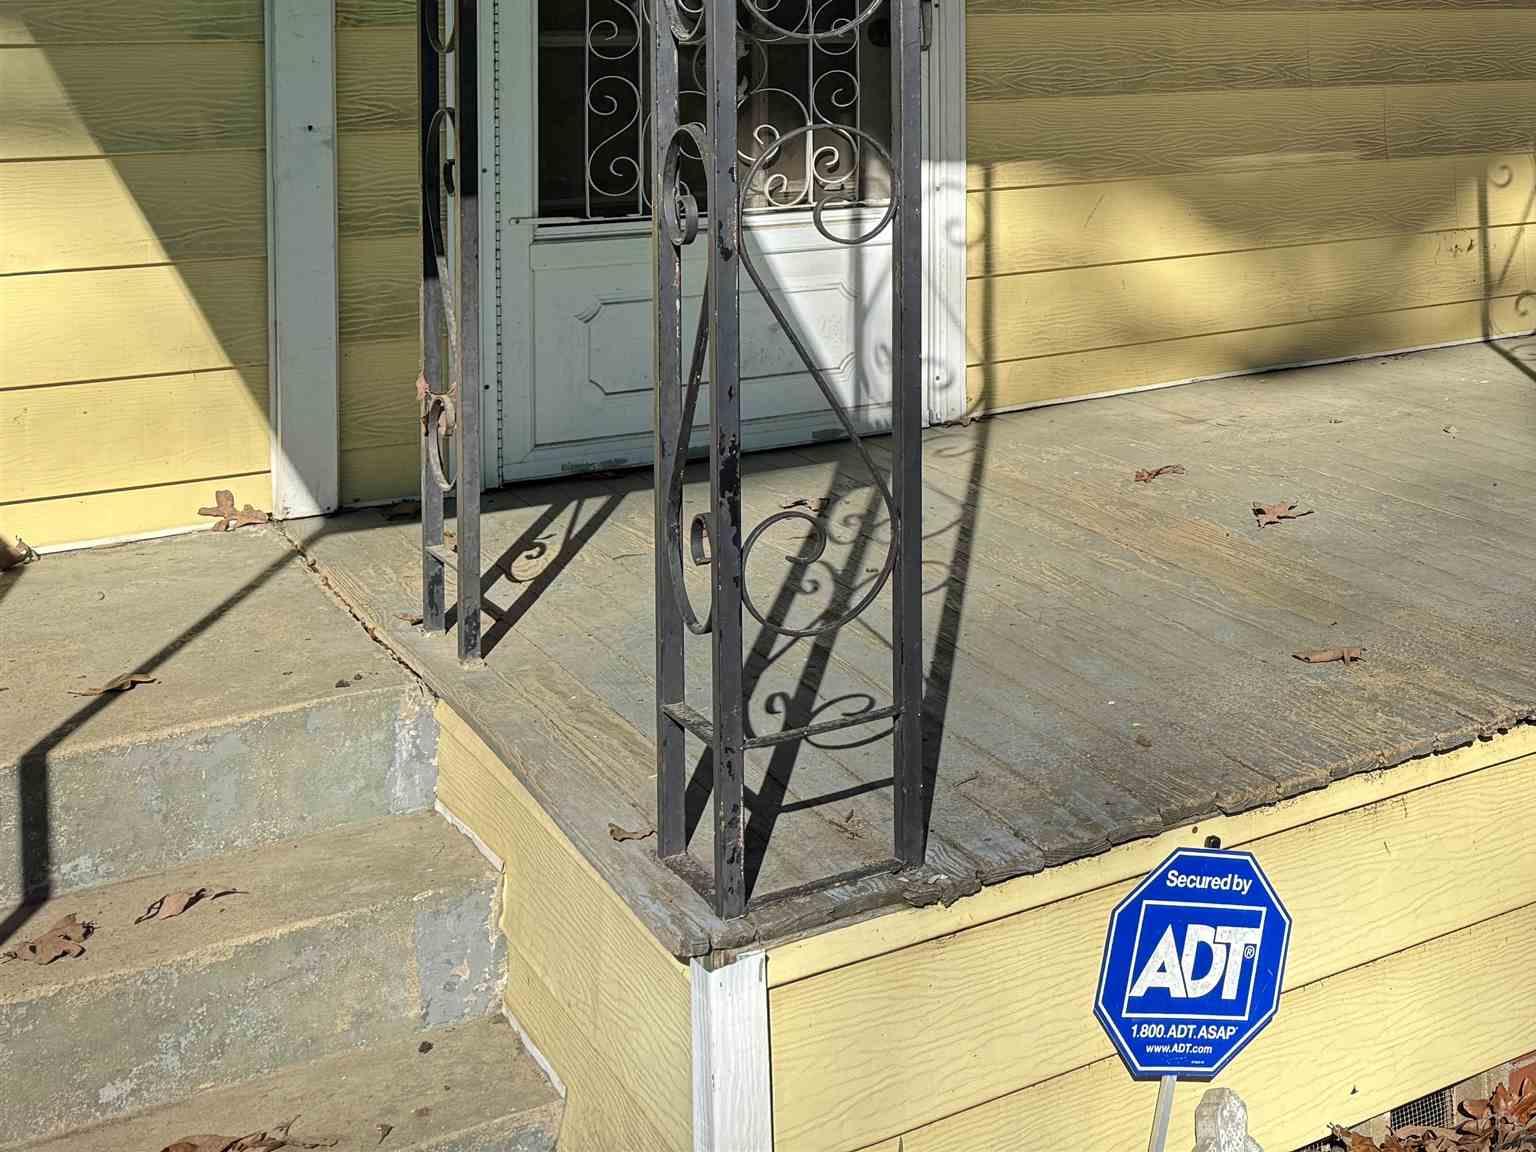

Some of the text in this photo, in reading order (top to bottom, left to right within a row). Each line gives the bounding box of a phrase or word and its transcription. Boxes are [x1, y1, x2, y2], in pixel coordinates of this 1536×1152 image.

[1166, 869, 1252, 895] Secured by
[1129, 923, 1260, 1000] ADT
[1131, 1023, 1237, 1040] 1.800.ADT.ASAP
[1145, 1043, 1213, 1054] www.ADT.com
